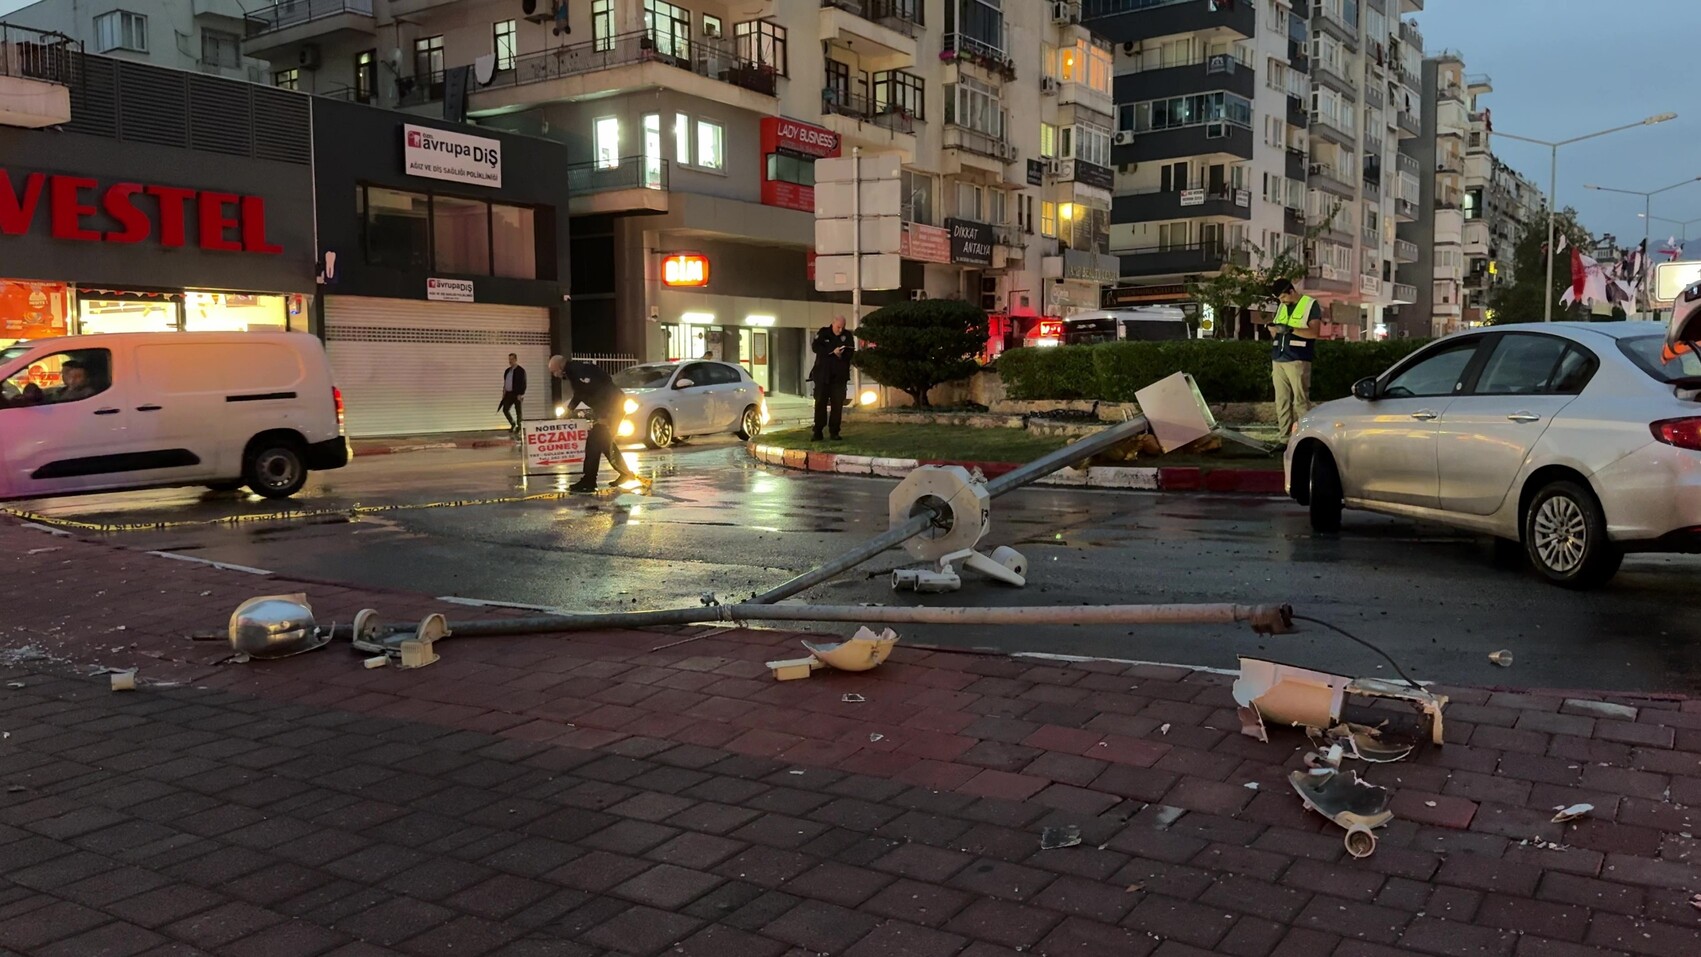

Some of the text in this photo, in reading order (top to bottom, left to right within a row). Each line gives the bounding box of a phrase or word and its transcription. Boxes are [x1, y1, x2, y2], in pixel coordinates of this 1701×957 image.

[777, 122, 799, 139] LADY
[799, 128, 834, 148] BUSINESS
[424, 164, 432, 172] VE
[0, 168, 285, 254] VESTEL
[953, 223, 979, 240] DİKKAT
[962, 241, 991, 256] ANTALYA
[527, 430, 586, 445] ECZANE
[538, 442, 579, 452] GÜNEŞ
